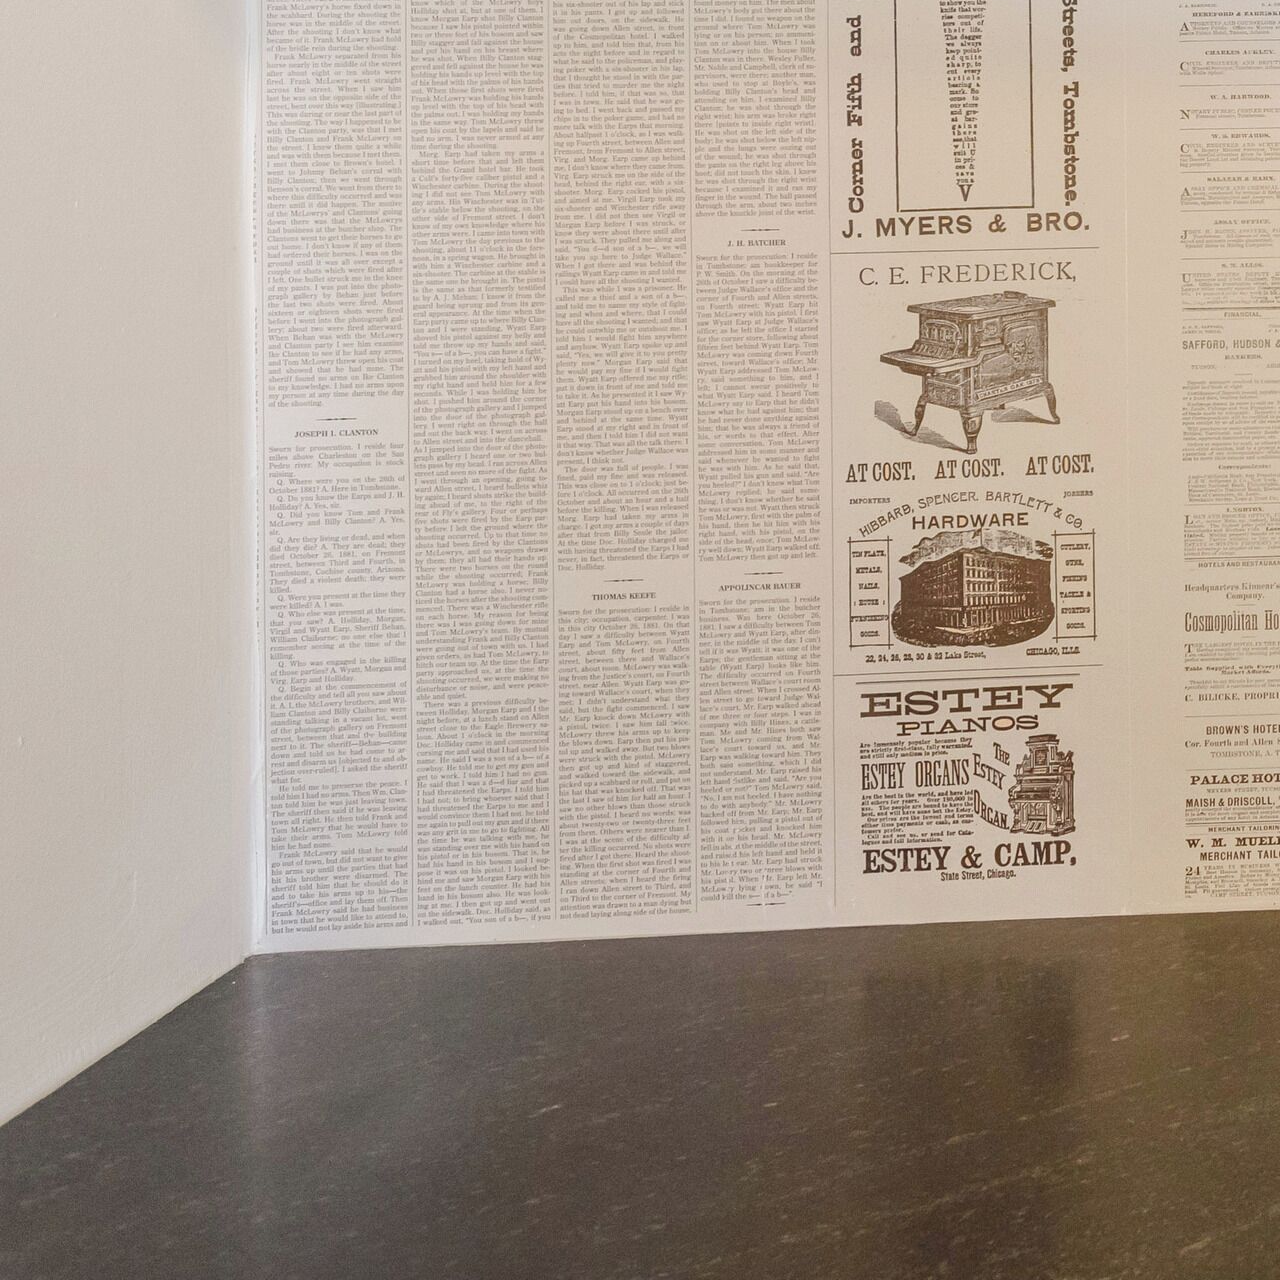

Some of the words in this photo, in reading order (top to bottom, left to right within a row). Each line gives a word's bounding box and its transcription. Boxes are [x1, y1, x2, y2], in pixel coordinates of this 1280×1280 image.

[846, 14, 862, 57] and
[846, 73, 863, 127] Fifth
[1063, 81, 1080, 206] Tombstone.
[848, 137, 864, 213] Corner
[842, 219, 862, 239] J.
[876, 215, 972, 238] MYERS
[988, 214, 1007, 233] &
[1027, 211, 1089, 232] BRO.
[859, 267, 878, 286] C.
[889, 267, 909, 285] E.
[920, 261, 1076, 284] FREDERICK,
[845, 463, 868, 483] AT
[872, 461, 915, 482] COST.
[934, 459, 957, 480] AT
[962, 458, 1004, 478] COST.
[1025, 456, 1048, 476] AT
[1052, 454, 1094, 475] COST.
[859, 504, 914, 537] HIBBARD,
[986, 491, 1053, 513] BARTLETT
[1065, 513, 1083, 531] CO.
[912, 512, 1029, 530] HARDWARE
[1184, 610, 1258, 634] Cosmopolitan
[860, 683, 1073, 718] ESTEY
[896, 715, 1039, 737] PIANOS
[1206, 725, 1249, 735] BROWN'S
[993, 742, 1010, 765] THE
[861, 762, 906, 791] ESTEY
[915, 758, 970, 788] ORGANS
[973, 753, 1007, 791] ESTEY
[1190, 774, 1249, 786] PALACE
[974, 789, 1009, 830] ORGAN.
[1186, 798, 1216, 809] MAISH
[1226, 796, 1275, 808] DRISCOLL,
[1185, 838, 1204, 848] W.
[1211, 838, 1227, 848] M.
[862, 846, 951, 874] ESTEY
[960, 845, 983, 872] &
[994, 840, 1076, 871] CAMP,
[1200, 850, 1252, 861] MERCHANT
[940, 871, 960, 882] State
[961, 870, 985, 880] Street,
[987, 868, 1016, 880] Chicago.
